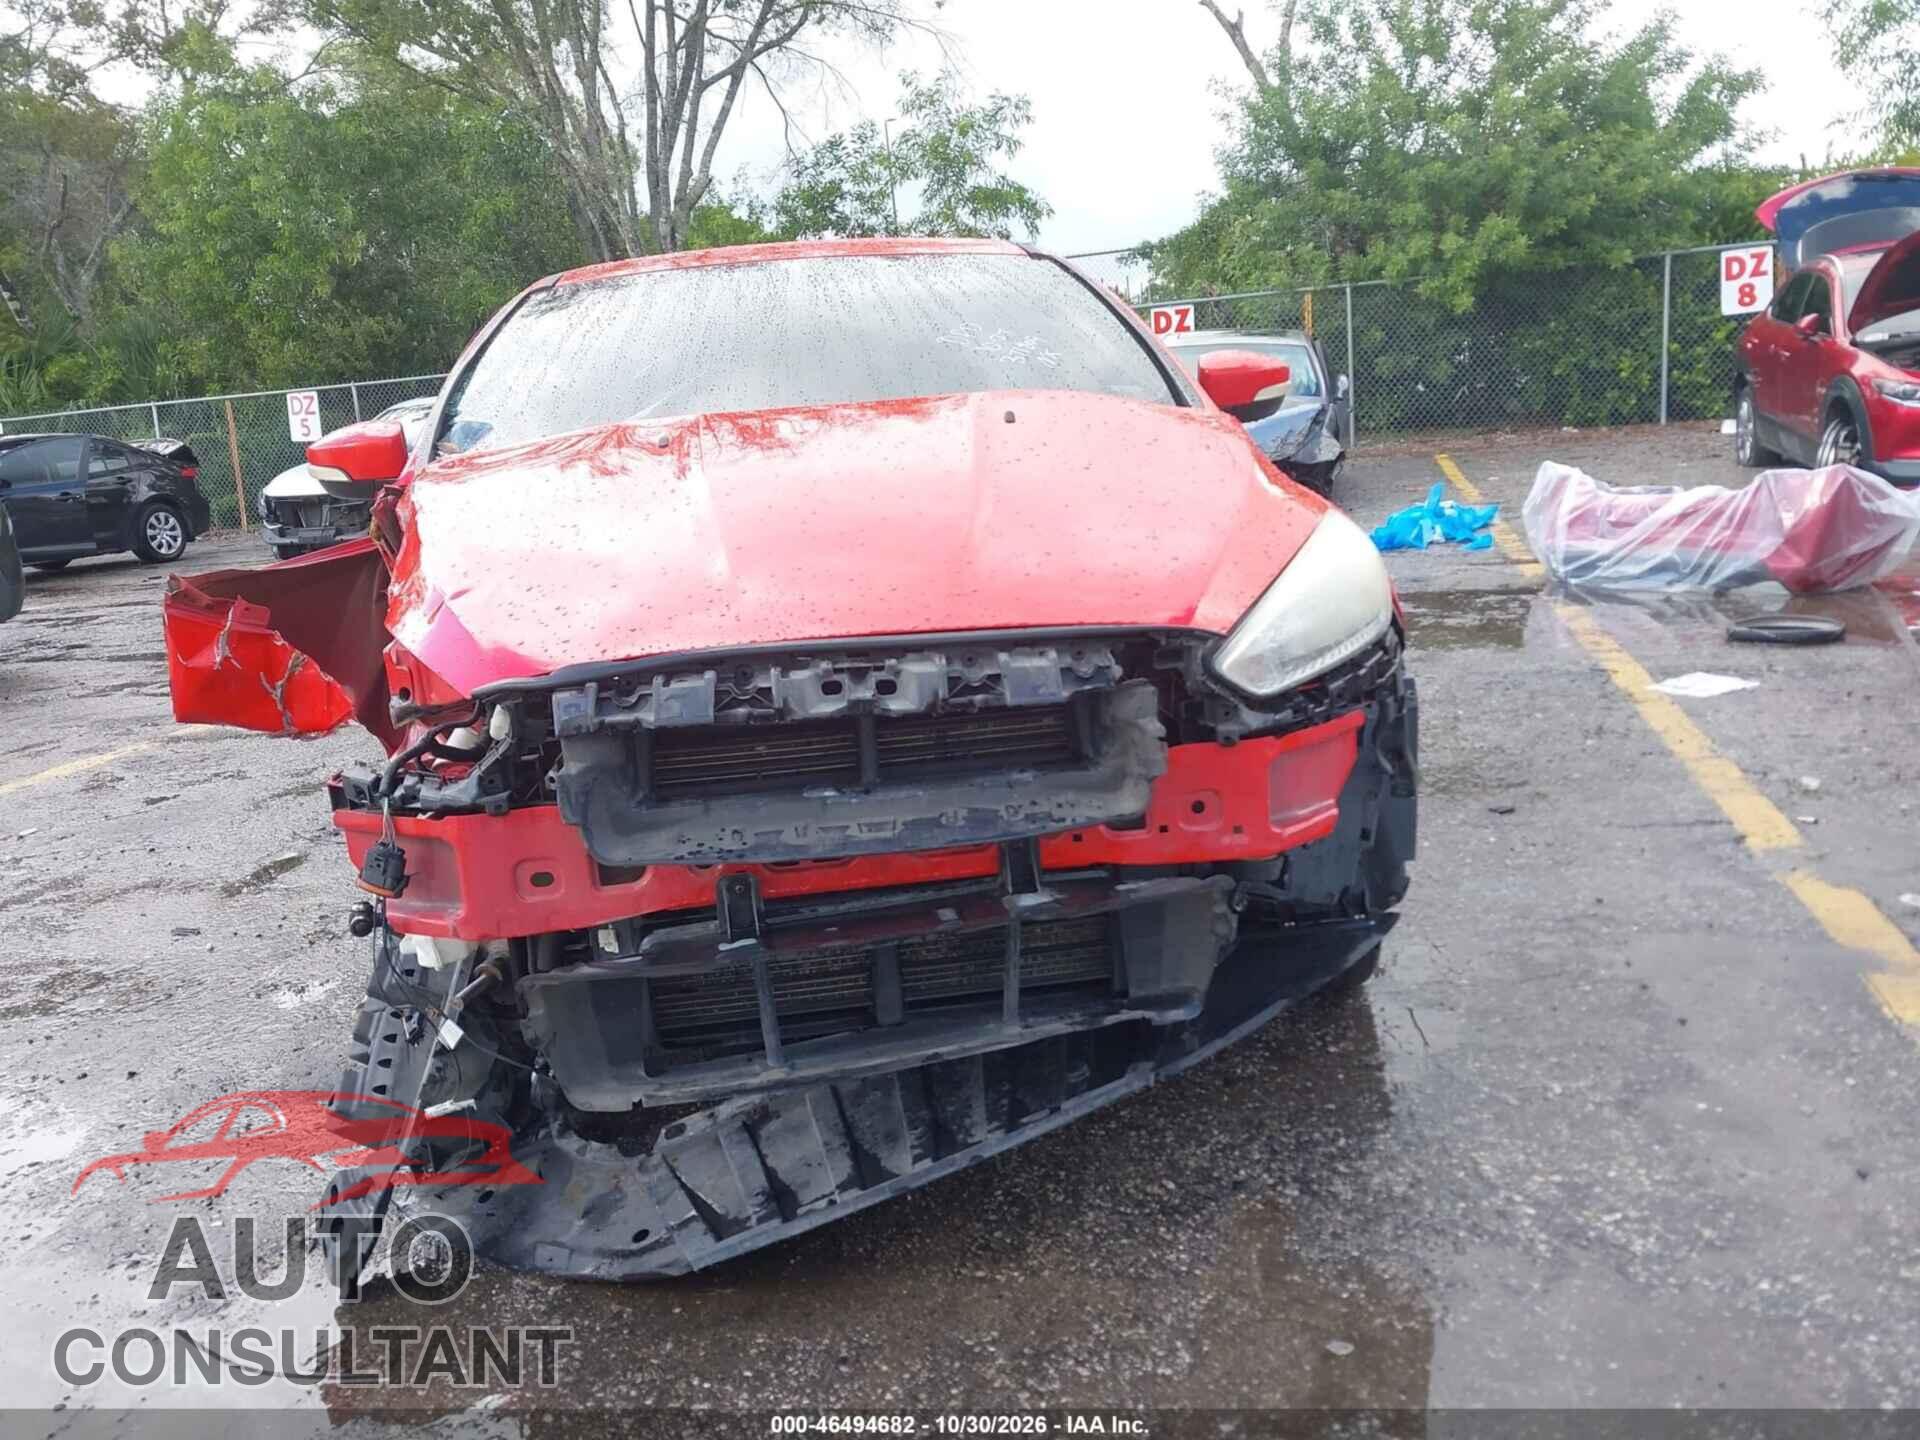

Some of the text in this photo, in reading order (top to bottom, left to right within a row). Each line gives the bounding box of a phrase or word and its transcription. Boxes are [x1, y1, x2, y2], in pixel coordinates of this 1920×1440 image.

[1725, 251, 1768, 281] DZ
[1738, 283, 1757, 307] 8
[1154, 308, 1191, 334] DZ
[289, 395, 316, 415] DZ
[300, 418, 311, 437] 5
